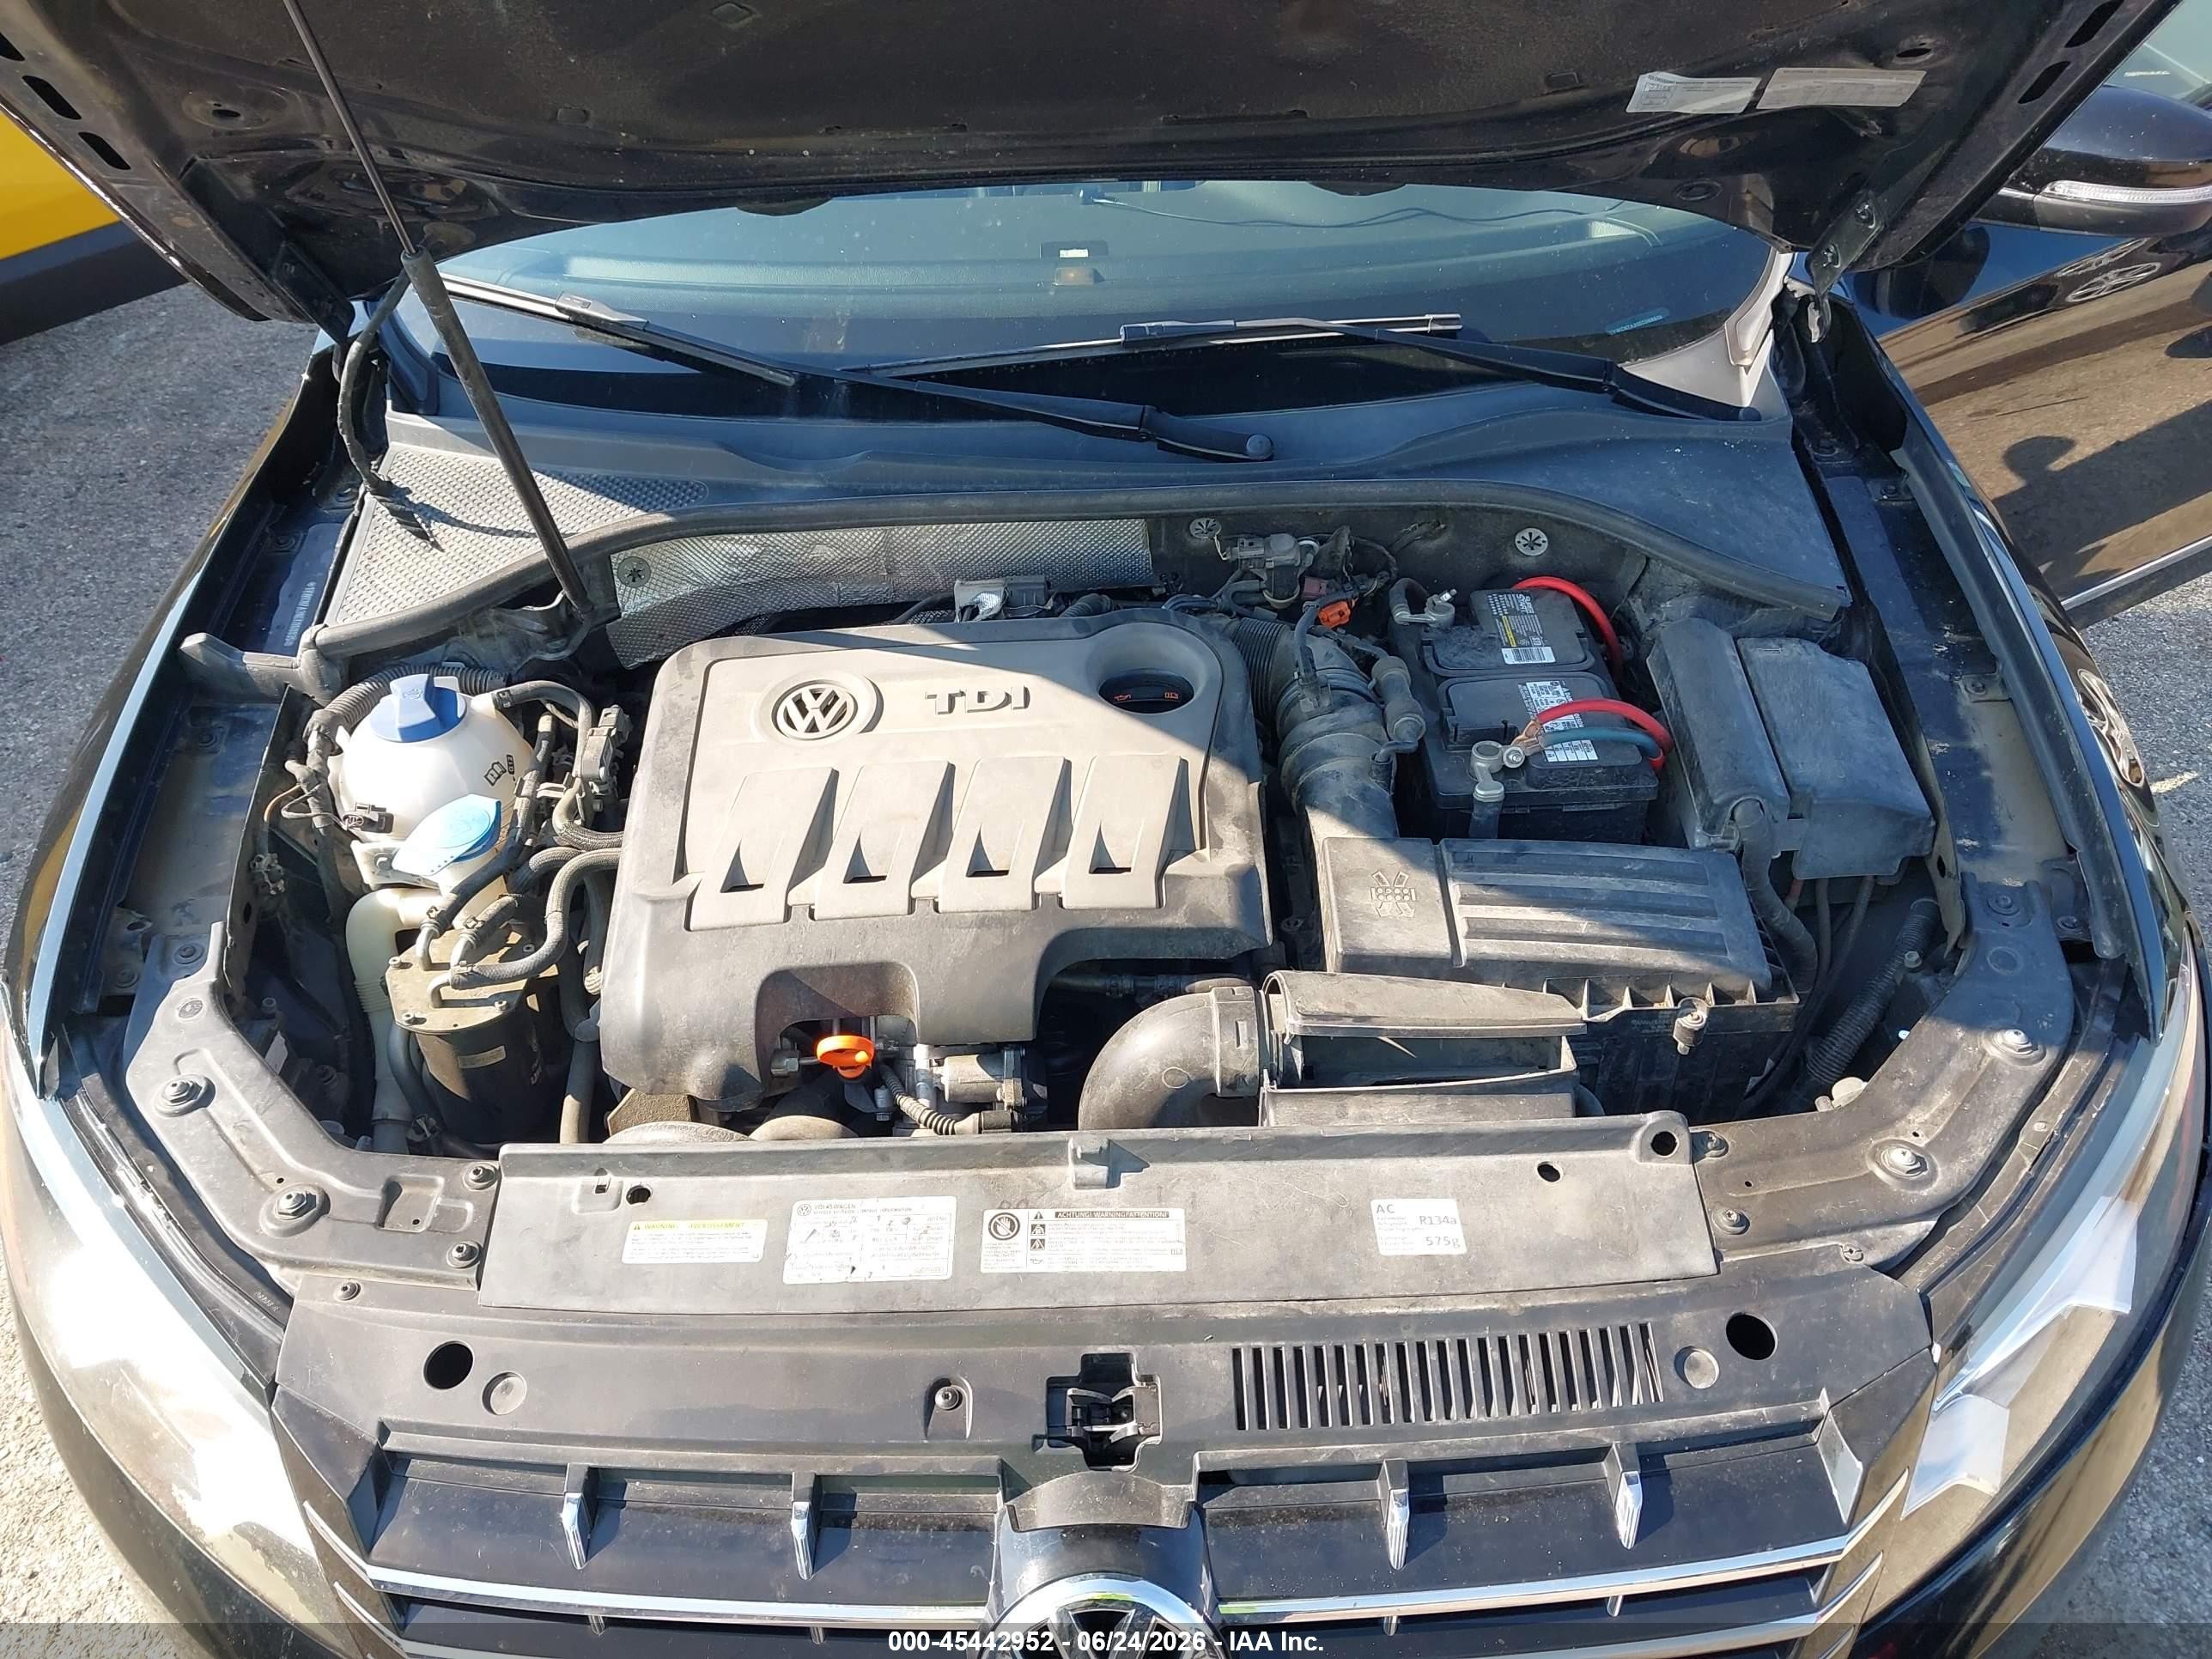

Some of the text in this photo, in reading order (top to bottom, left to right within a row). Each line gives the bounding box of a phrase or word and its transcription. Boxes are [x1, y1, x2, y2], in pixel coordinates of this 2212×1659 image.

[925, 685, 1030, 714] TDI
[1376, 1204, 1395, 1214] AC
[1419, 1215, 1457, 1225] R134a
